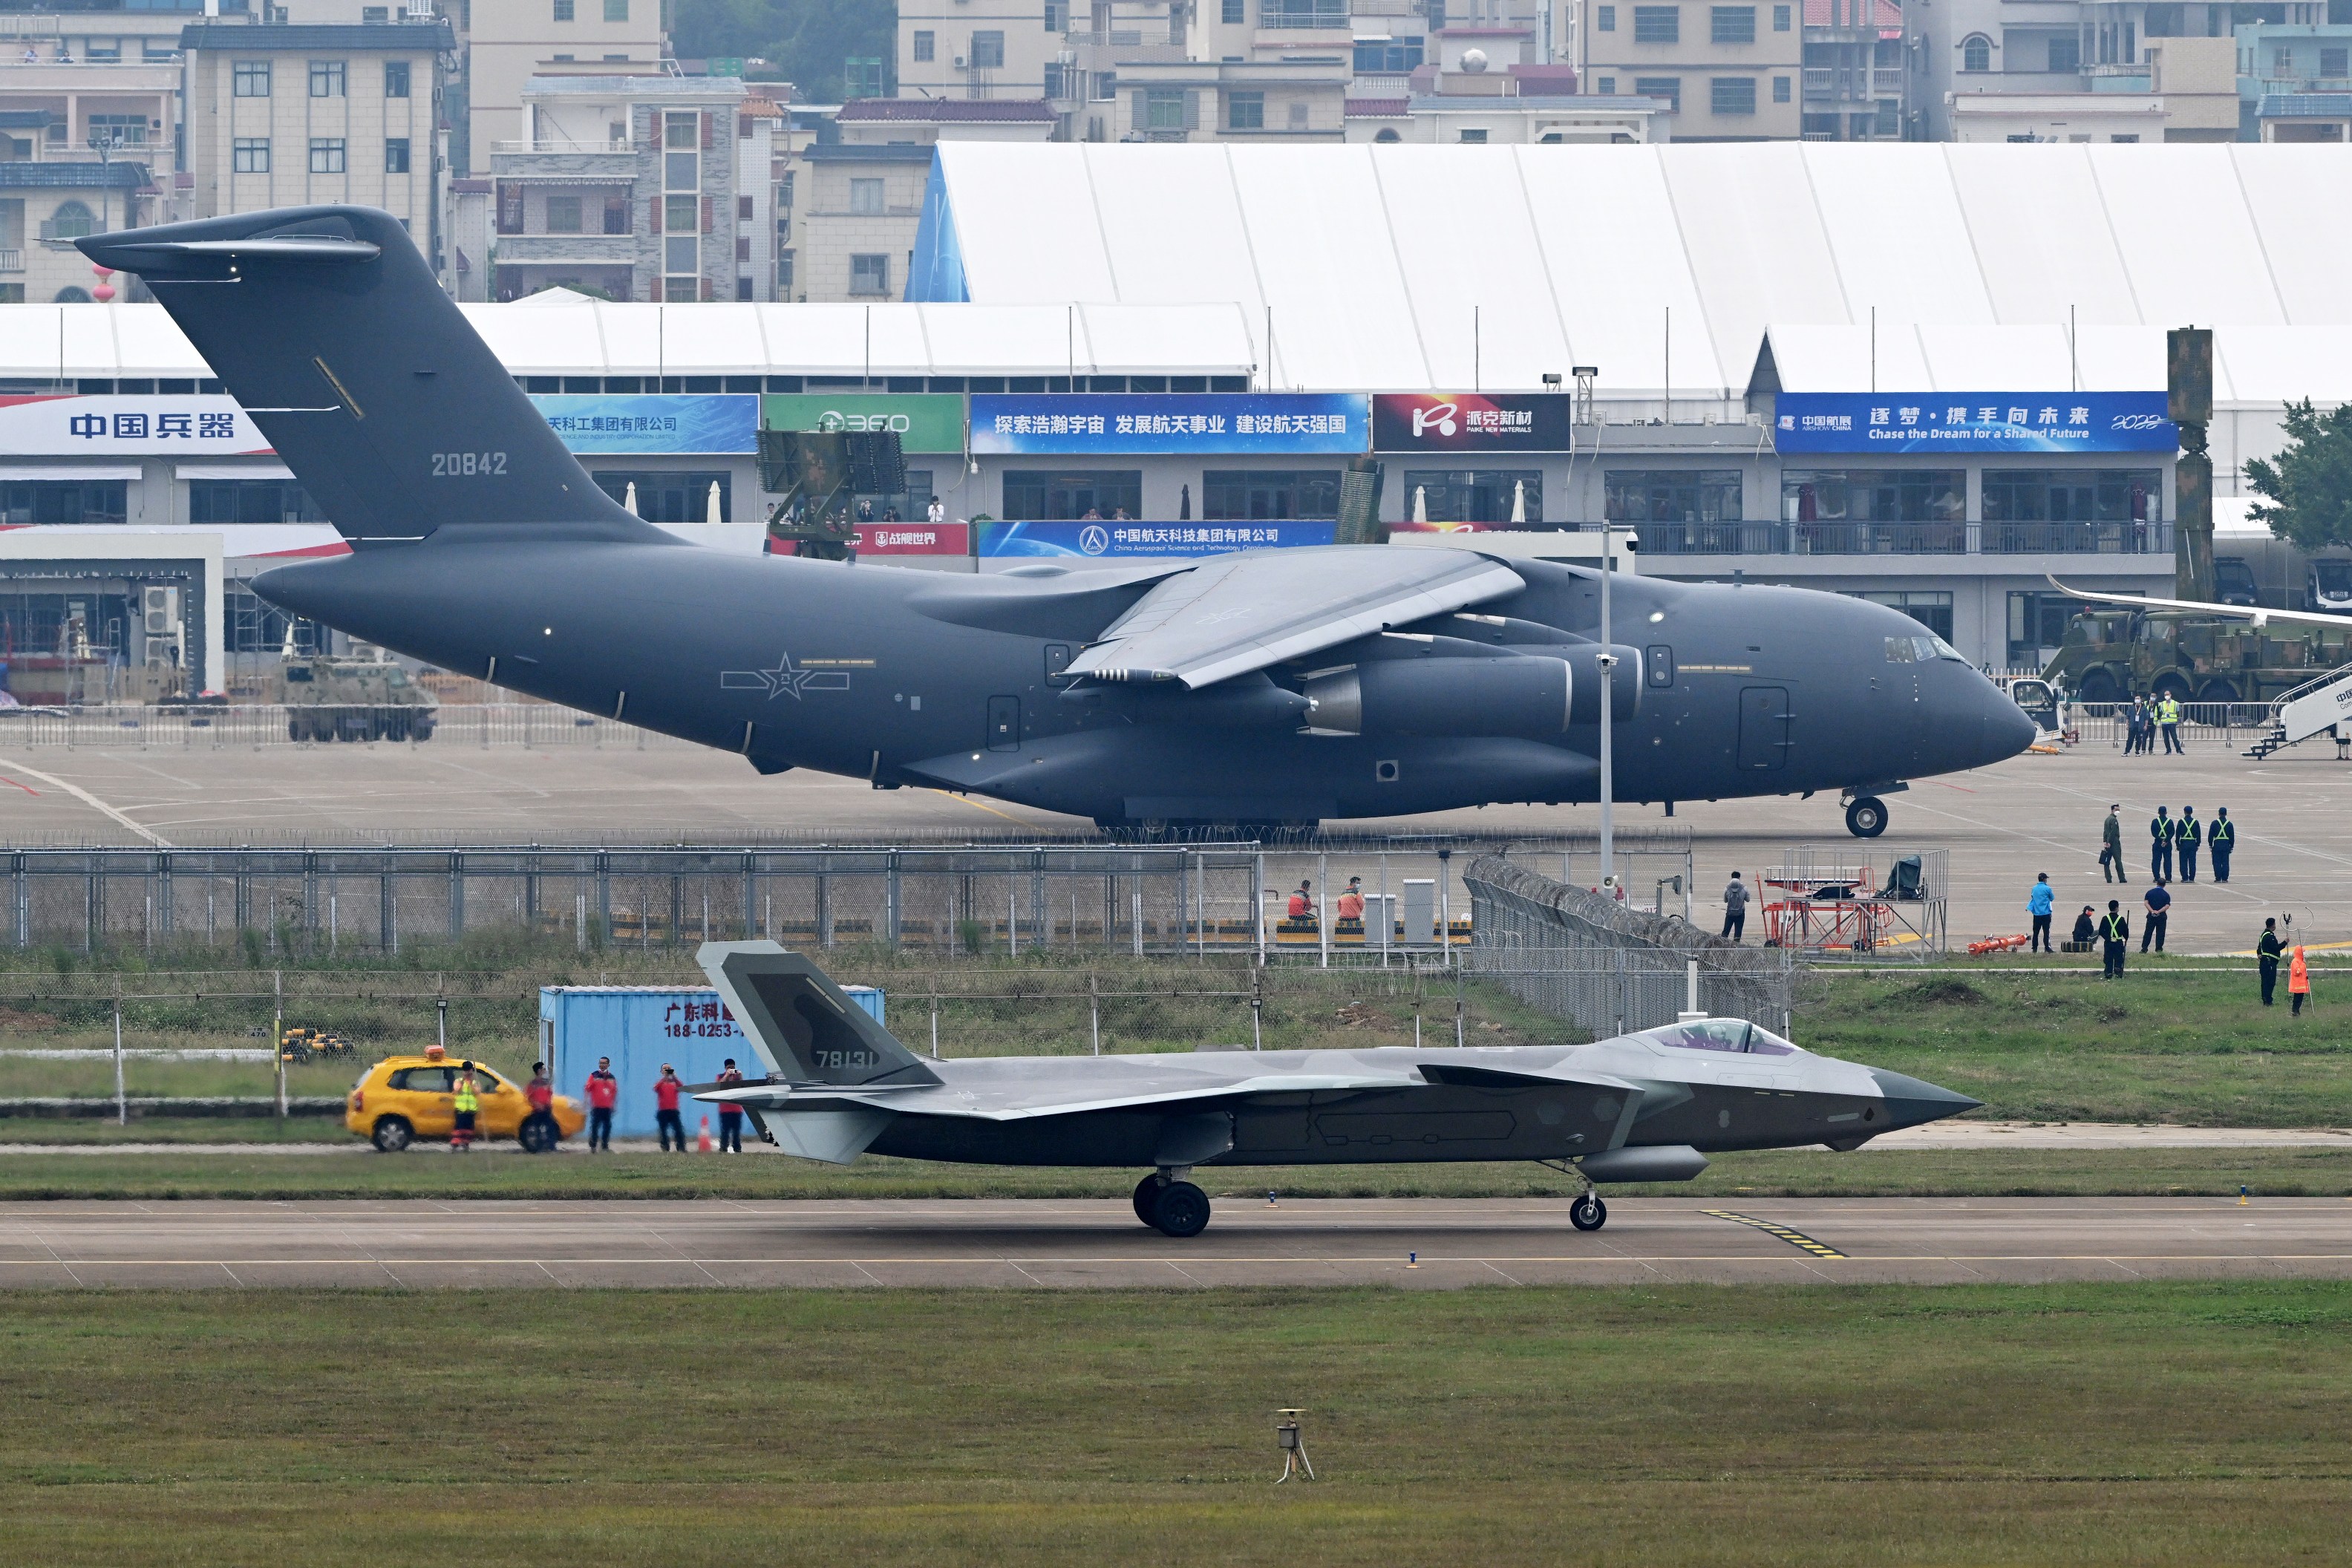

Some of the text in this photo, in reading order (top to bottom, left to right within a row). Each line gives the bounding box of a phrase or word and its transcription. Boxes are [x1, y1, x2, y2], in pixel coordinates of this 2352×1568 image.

[546, 416, 676, 431] 天科工集团有限公司
[846, 414, 909, 432] 360
[995, 415, 1346, 434] 探索浩瀚宇宙 发展航天事业 建设航天强国
[1466, 411, 1532, 425] 派克新材
[1802, 415, 1852, 426] 中国航展
[2111, 414, 2163, 430] 2022
[71, 414, 234, 439] 中国兵器
[1869, 428, 1905, 440] Chase
[1907, 428, 1927, 439] the
[1931, 428, 1970, 439] Dream
[1974, 428, 1991, 439] for
[2005, 428, 2047, 439] Shared
[2050, 428, 2089, 439] Future
[431, 451, 507, 476] 20842
[889, 532, 936, 545] 战舰世界
[1114, 528, 1278, 543] 中国航天科技集团有限公司
[1206, 544, 1241, 552] Technology
[664, 1024, 745, 1038] 188-0253-
[817, 1051, 873, 1069] 78131
